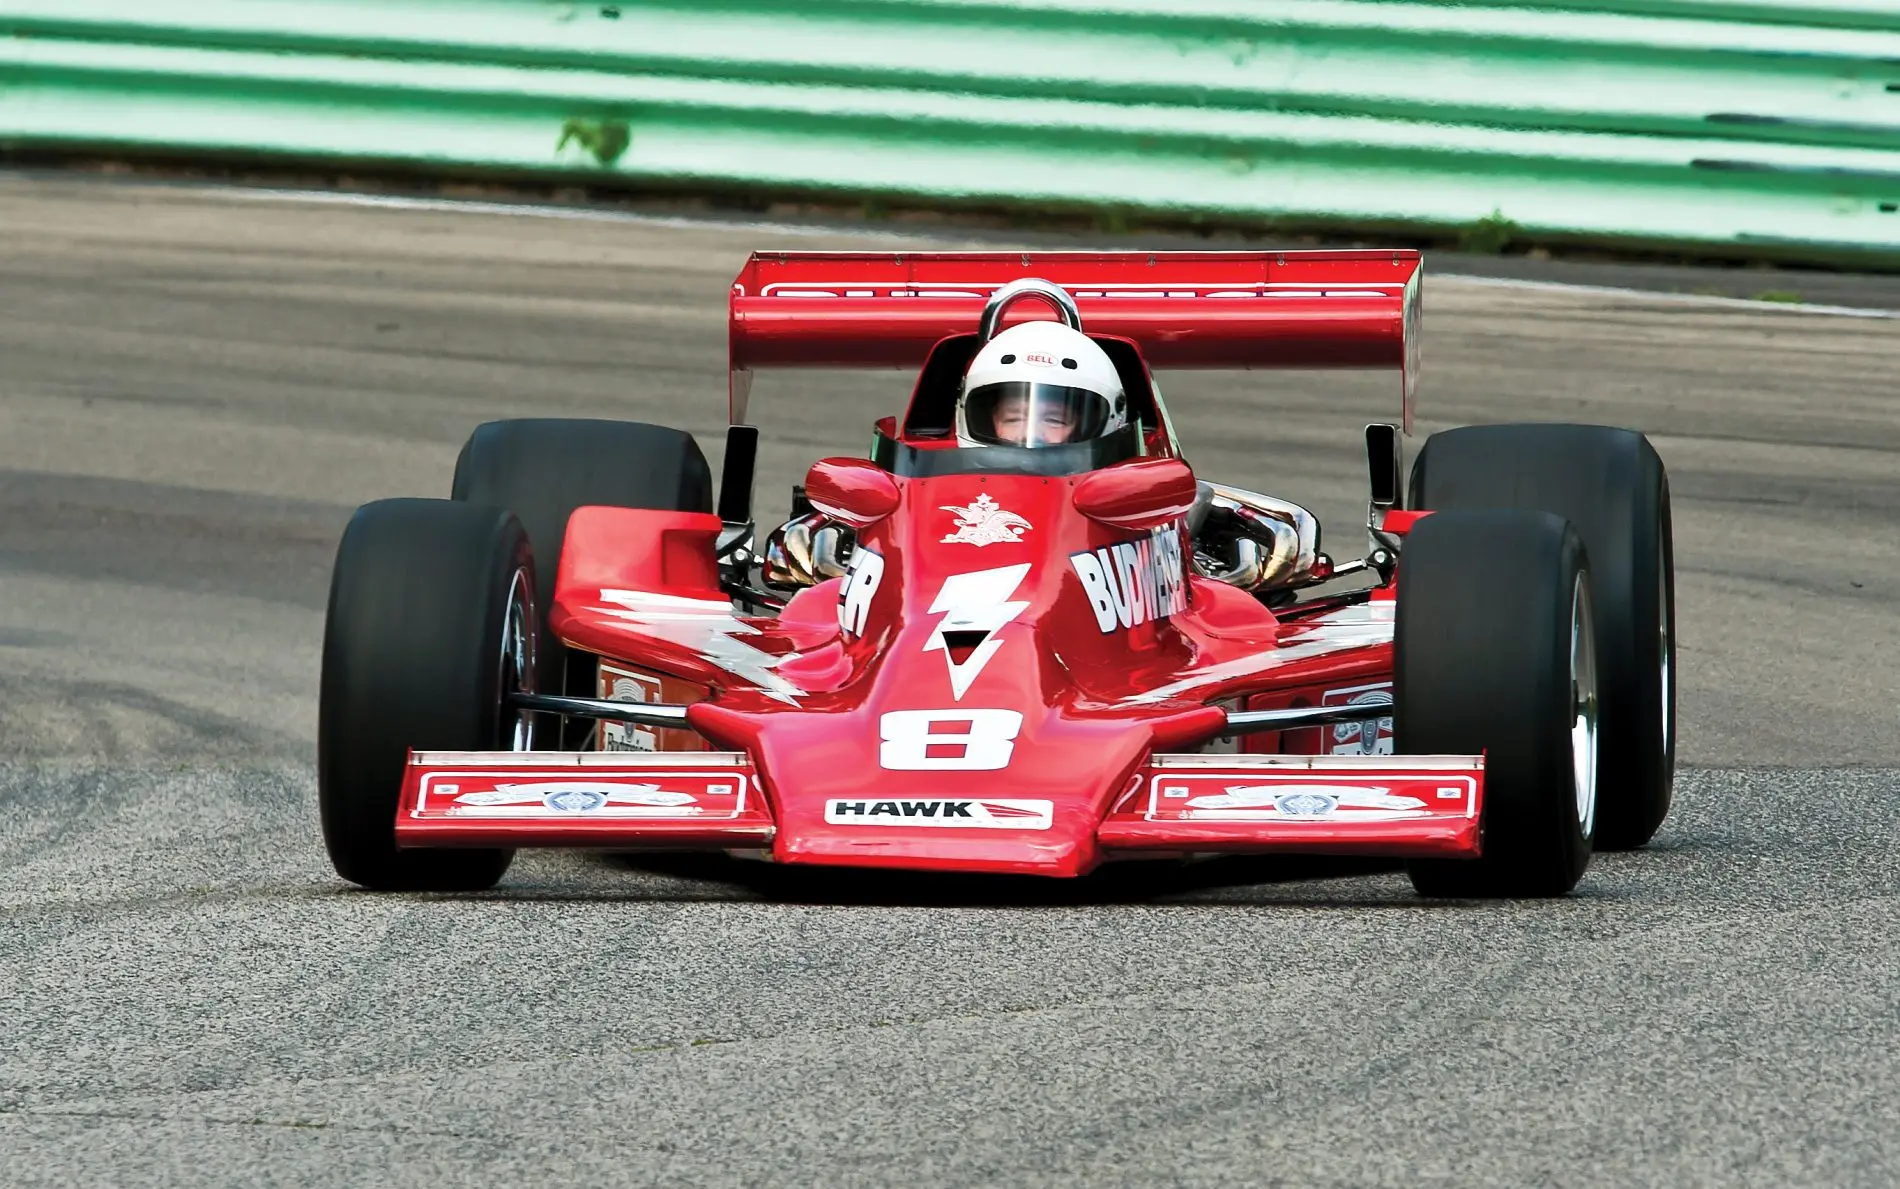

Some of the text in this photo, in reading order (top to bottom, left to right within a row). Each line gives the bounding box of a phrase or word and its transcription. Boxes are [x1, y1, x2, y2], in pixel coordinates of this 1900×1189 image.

[1027, 354, 1054, 365] BELL
[879, 708, 1024, 771] 8
[835, 801, 974, 818] HAWK
